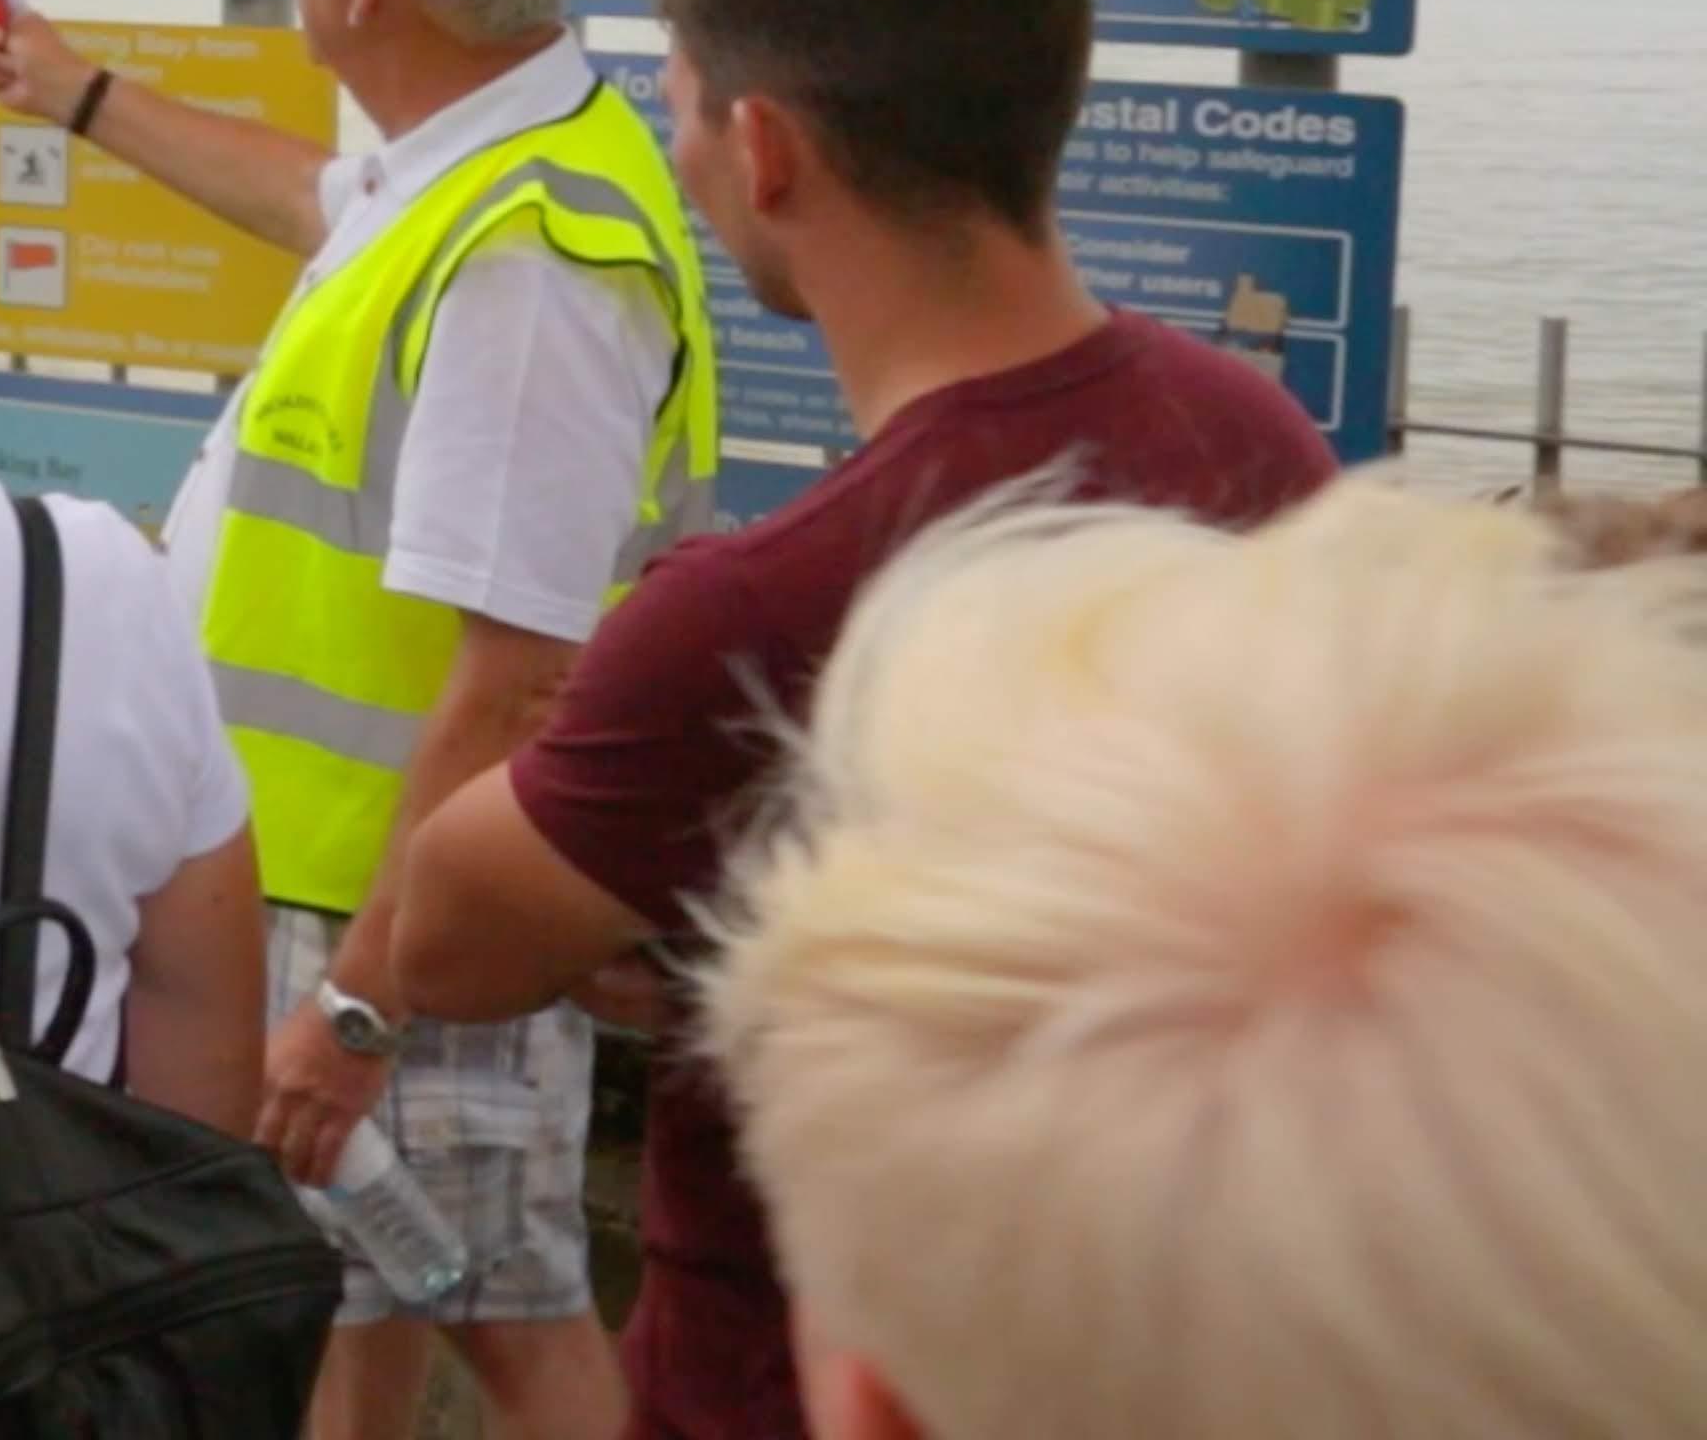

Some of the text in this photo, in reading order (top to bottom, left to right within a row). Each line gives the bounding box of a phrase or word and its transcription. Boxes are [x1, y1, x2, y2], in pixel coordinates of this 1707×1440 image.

[1077, 96, 1357, 146] stal Codes
[1102, 140, 1132, 163] to
[1137, 142, 1200, 169] help
[1207, 148, 1356, 181] safeguard
[1140, 274, 1223, 299] users
